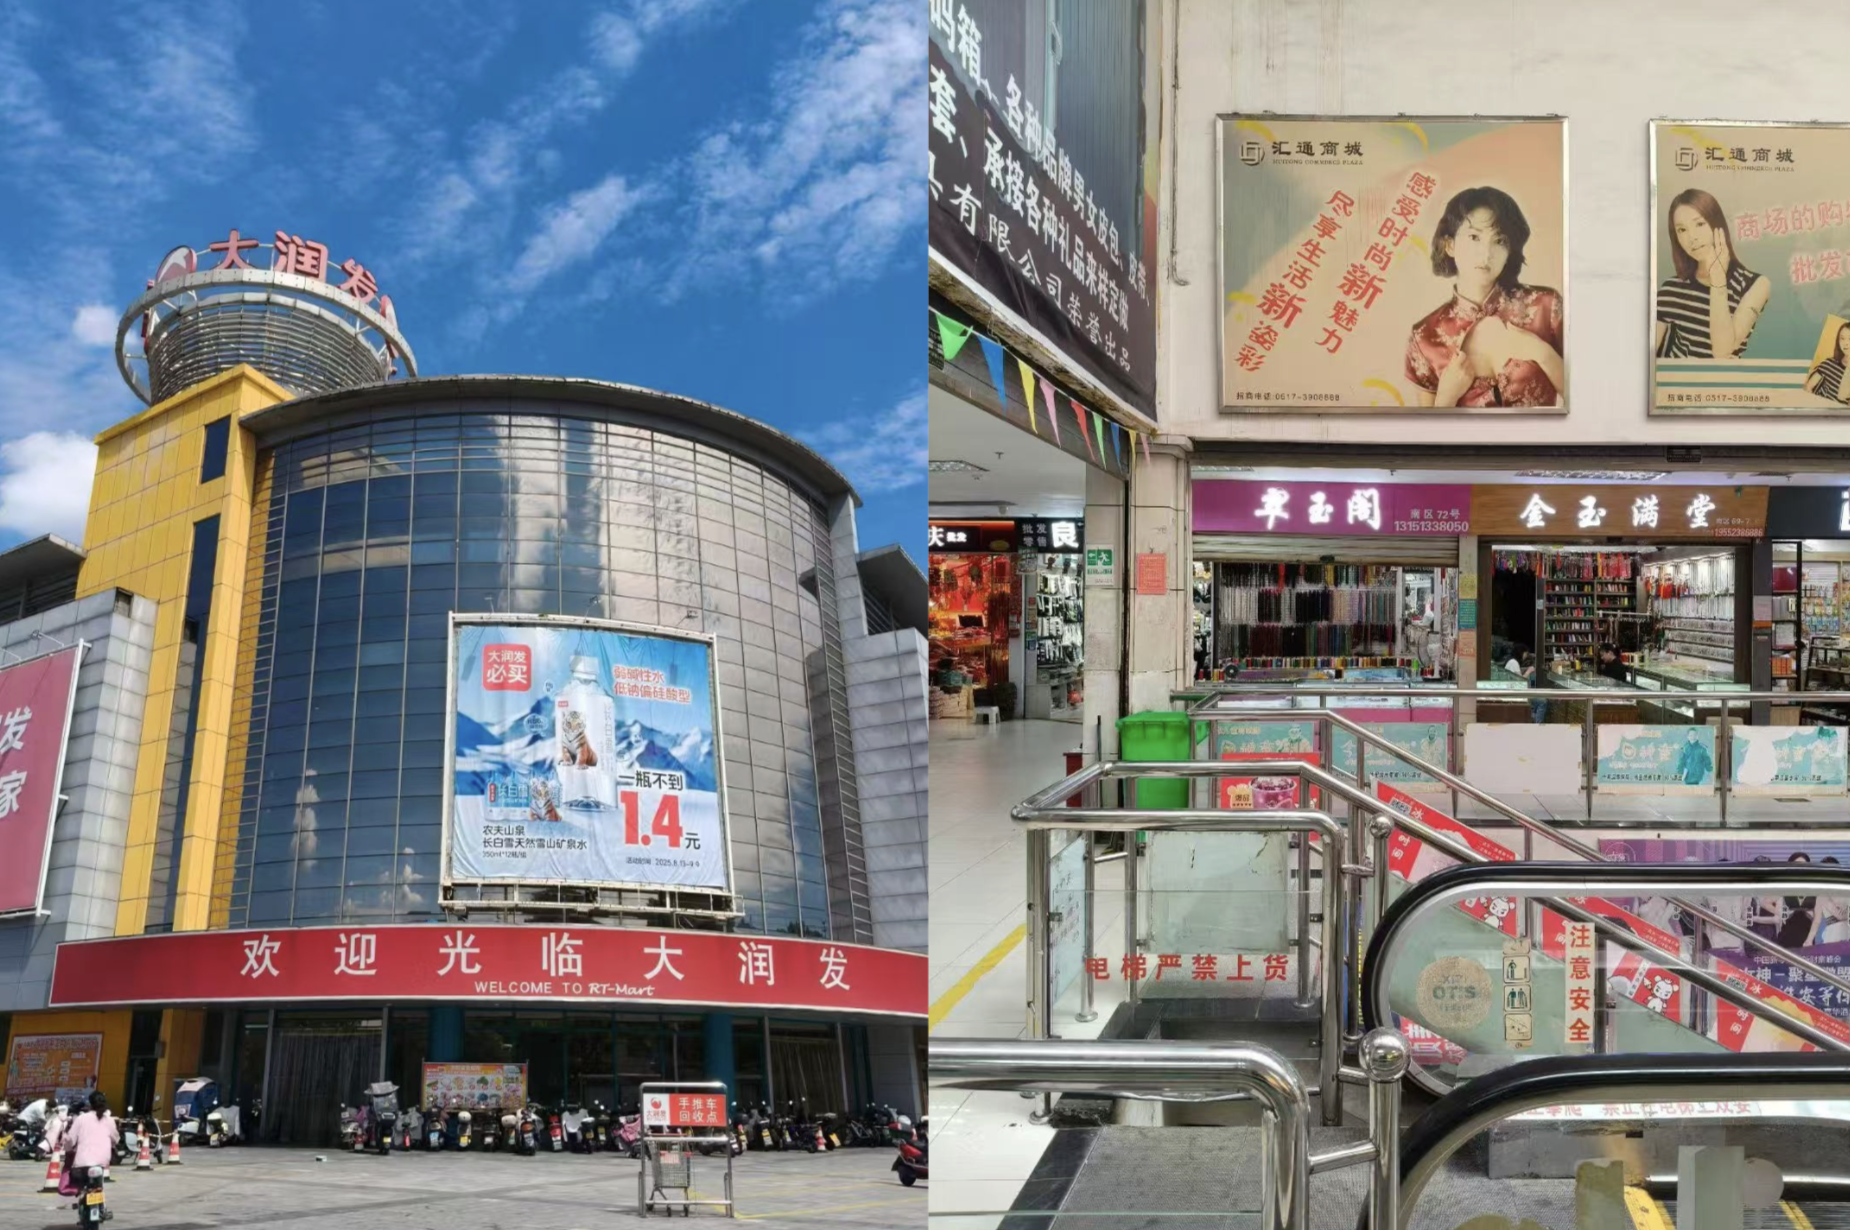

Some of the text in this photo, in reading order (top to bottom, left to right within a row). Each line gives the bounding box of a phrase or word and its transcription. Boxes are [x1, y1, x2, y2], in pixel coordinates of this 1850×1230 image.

[1272, 141, 1364, 157] 汇通商城
[1705, 147, 1795, 163] 汇通商城
[1736, 197, 1850, 240] 商场的购
[208, 228, 379, 301] 大润发
[1315, 171, 1438, 354] 感受时尚新魅力
[1791, 250, 1850, 284] 批发
[1235, 190, 1355, 373] 尽享生活新姿彩
[1519, 492, 1716, 529] 金玉满堂
[1022, 523, 1048, 535] 批发
[1394, 521, 1470, 533] 13151338050
[1023, 536, 1048, 548] 零售
[487, 650, 527, 665] 大润发
[486, 664, 528, 685] 必买
[613, 666, 665, 682] 弱碱性水
[613, 682, 692, 704] 低钠偏硅酸型
[618, 770, 684, 791] 一瓶不到
[619, 791, 683, 849] 1.4
[482, 824, 526, 837] 农夫山泉
[482, 837, 588, 851] 长白雪天然雪山矿泉水
[684, 832, 701, 851] 元
[239, 930, 851, 991] 欢迎光临大润发
[1085, 954, 1290, 982] 电梯严禁上货
[474, 980, 655, 997] WELCOME TO RT-Mart
[1569, 925, 1592, 1043] 注意安全
[679, 1097, 718, 1110] 手推车
[679, 1110, 718, 1123] 回收点
